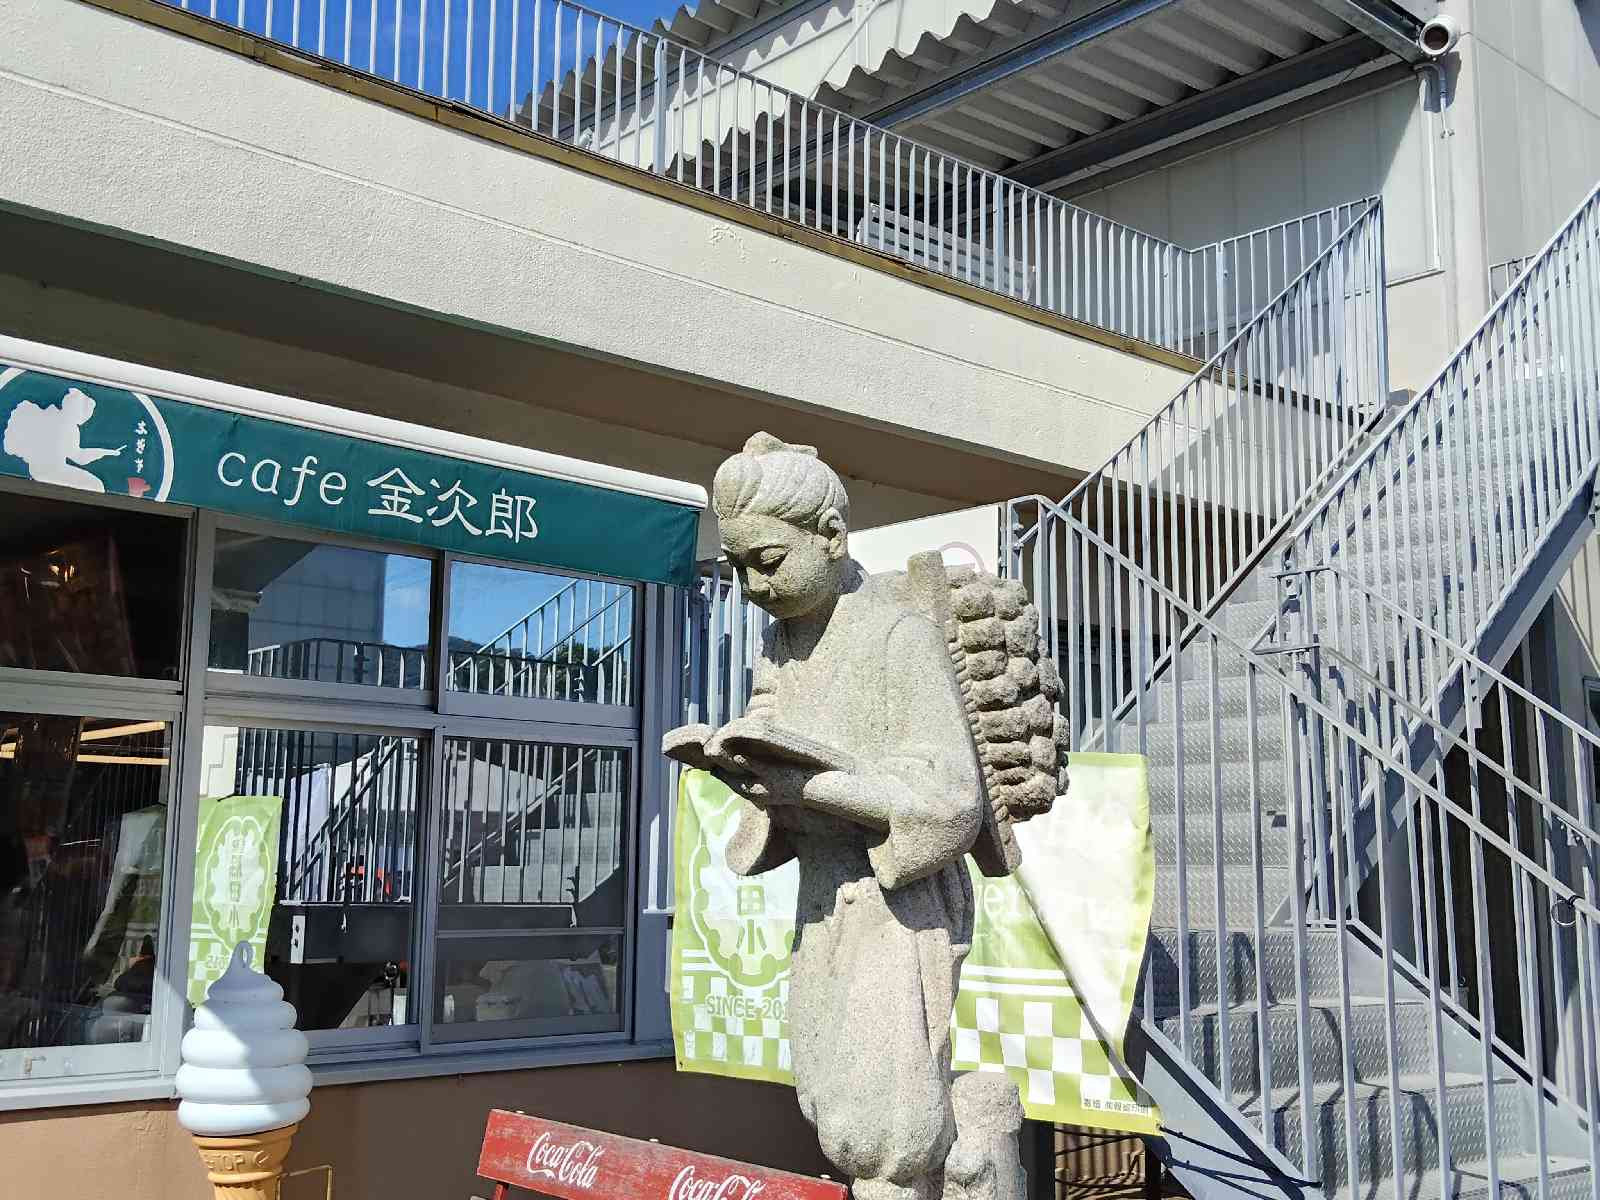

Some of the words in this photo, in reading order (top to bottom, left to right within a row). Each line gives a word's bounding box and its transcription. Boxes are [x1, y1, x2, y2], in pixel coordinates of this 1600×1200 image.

[217, 449, 347, 507] cafe
[366, 466, 539, 544] 金次郎
[705, 993, 756, 1019] SINCE
[526, 1131, 606, 1189] Coca-Cola
